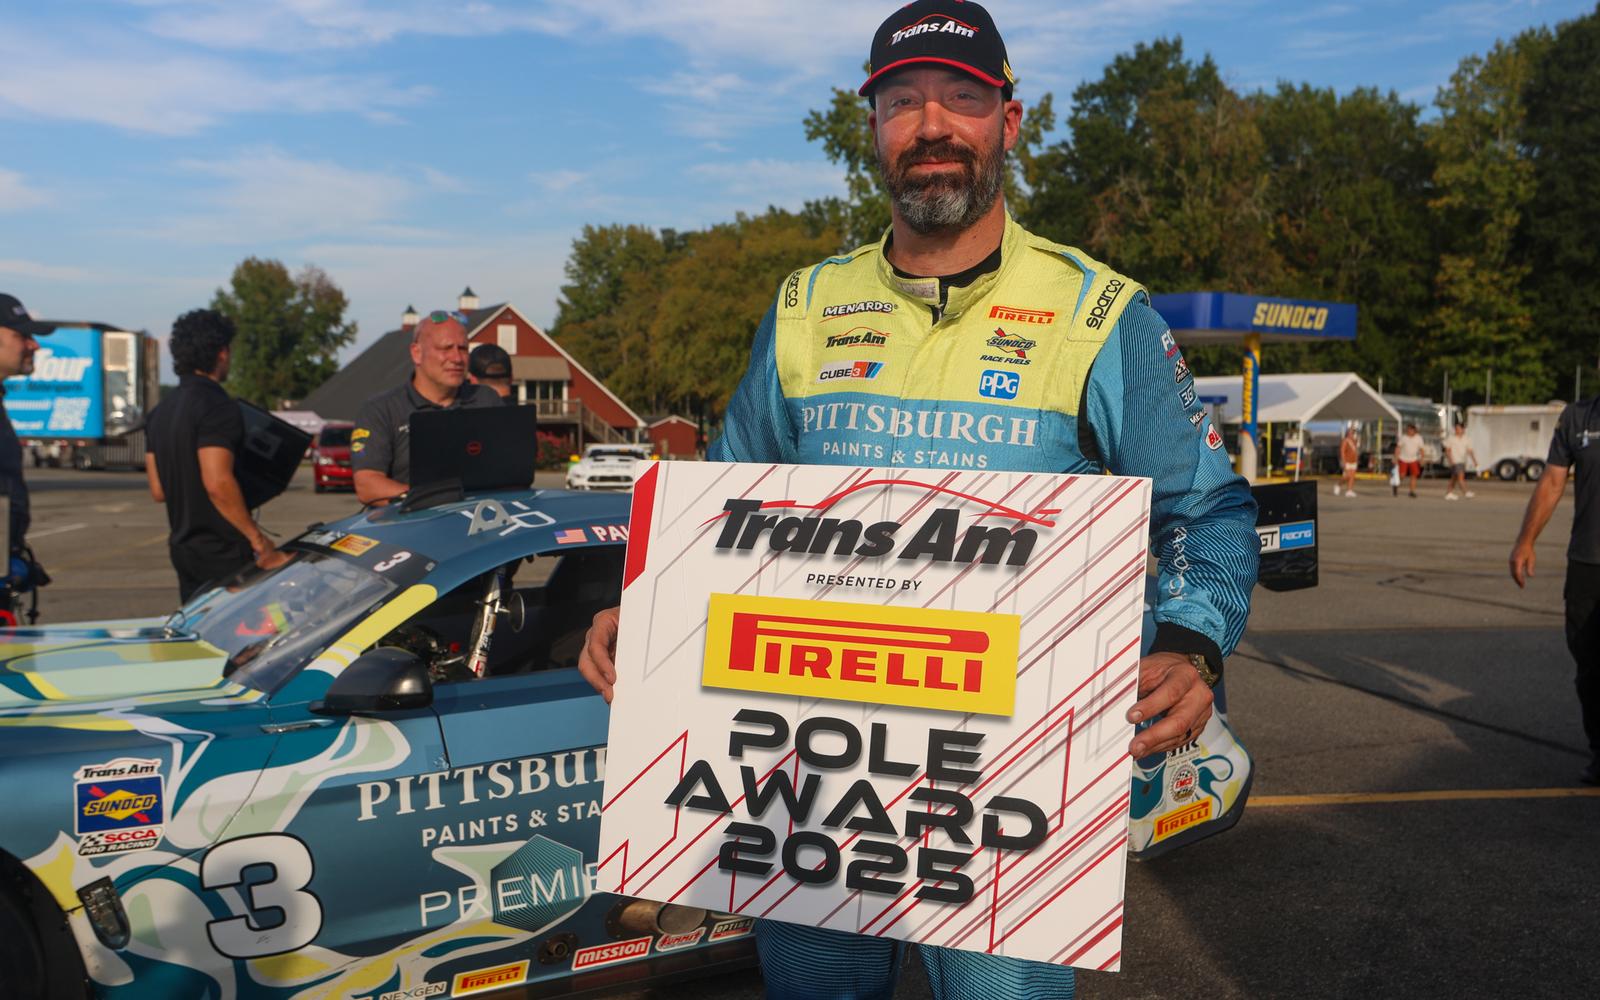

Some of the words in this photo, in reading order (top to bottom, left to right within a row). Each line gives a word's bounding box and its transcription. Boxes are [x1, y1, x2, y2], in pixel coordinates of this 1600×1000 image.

[890, 22, 939, 46] Trans
[939, 20, 975, 38] Am
[823, 301, 893, 317] MENARDS
[988, 305, 1055, 324] PIRELLI
[1086, 279, 1125, 330] sparco
[1252, 303, 1328, 331] SUNOCO
[826, 336, 861, 348] Trans
[861, 332, 886, 344] Am
[990, 337, 1033, 349] SUNOCO
[980, 355, 1003, 363] RACE
[1004, 356, 1031, 365] FUELS
[981, 372, 1018, 396] PPG
[803, 402, 1039, 447] PITTSBURGH
[822, 441, 884, 459] PAINTS
[890, 449, 905, 464] &
[914, 450, 988, 468] STAINS
[713, 498, 902, 558] Trans
[898, 508, 1039, 567] Am
[806, 573, 897, 590] PRESENTED
[900, 579, 923, 591] BY
[728, 612, 990, 693] PIRELLI
[728, 708, 986, 785] POLE
[83, 767, 125, 778] Trans
[128, 764, 155, 775] Am
[87, 796, 154, 814] SUNOCO
[663, 759, 1049, 852] AWARD
[422, 814, 518, 847] PAINTS
[528, 809, 547, 828] &
[1157, 801, 1210, 836] PIRELLI
[80, 846, 106, 855] PRO
[107, 839, 157, 851] RACING
[104, 830, 157, 843] SCCA
[718, 820, 976, 903] 2025
[199, 832, 325, 960] 3
[461, 966, 520, 989] PIRELLI
